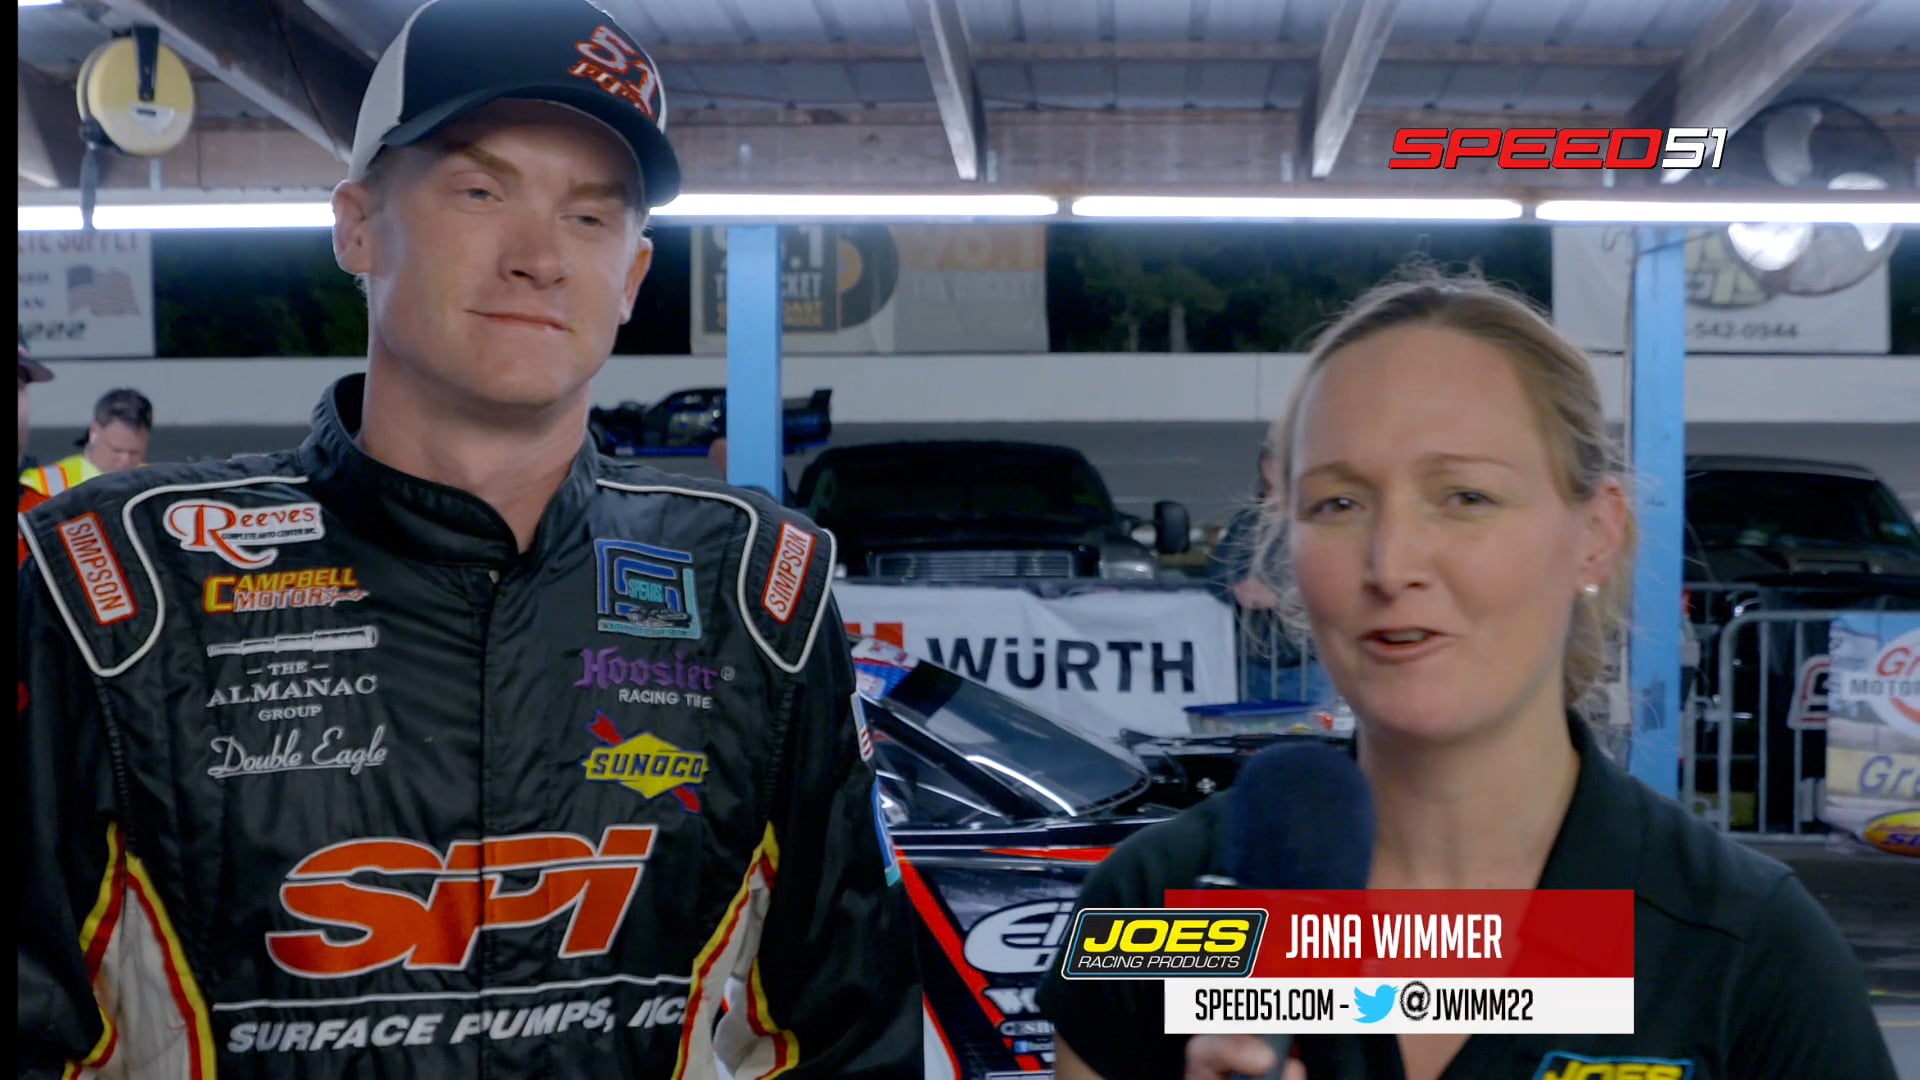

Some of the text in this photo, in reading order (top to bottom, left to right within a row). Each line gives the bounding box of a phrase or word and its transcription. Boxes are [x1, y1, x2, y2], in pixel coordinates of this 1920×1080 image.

[168, 503, 316, 564] Reeves
[66, 520, 128, 613] SIMPSON
[770, 529, 808, 614] SIMPSON
[204, 567, 359, 613] CAMPBELL
[267, 661, 309, 676] THE
[573, 645, 718, 690] Hoosier
[206, 674, 378, 708] ALMANAC
[258, 703, 322, 721] GROUP
[618, 687, 680, 705] RACING
[207, 724, 388, 778] Double Eagle
[591, 753, 704, 778] SUNOCO
[228, 1013, 444, 1053] SURFACE
[627, 996, 686, 1029] IC.
